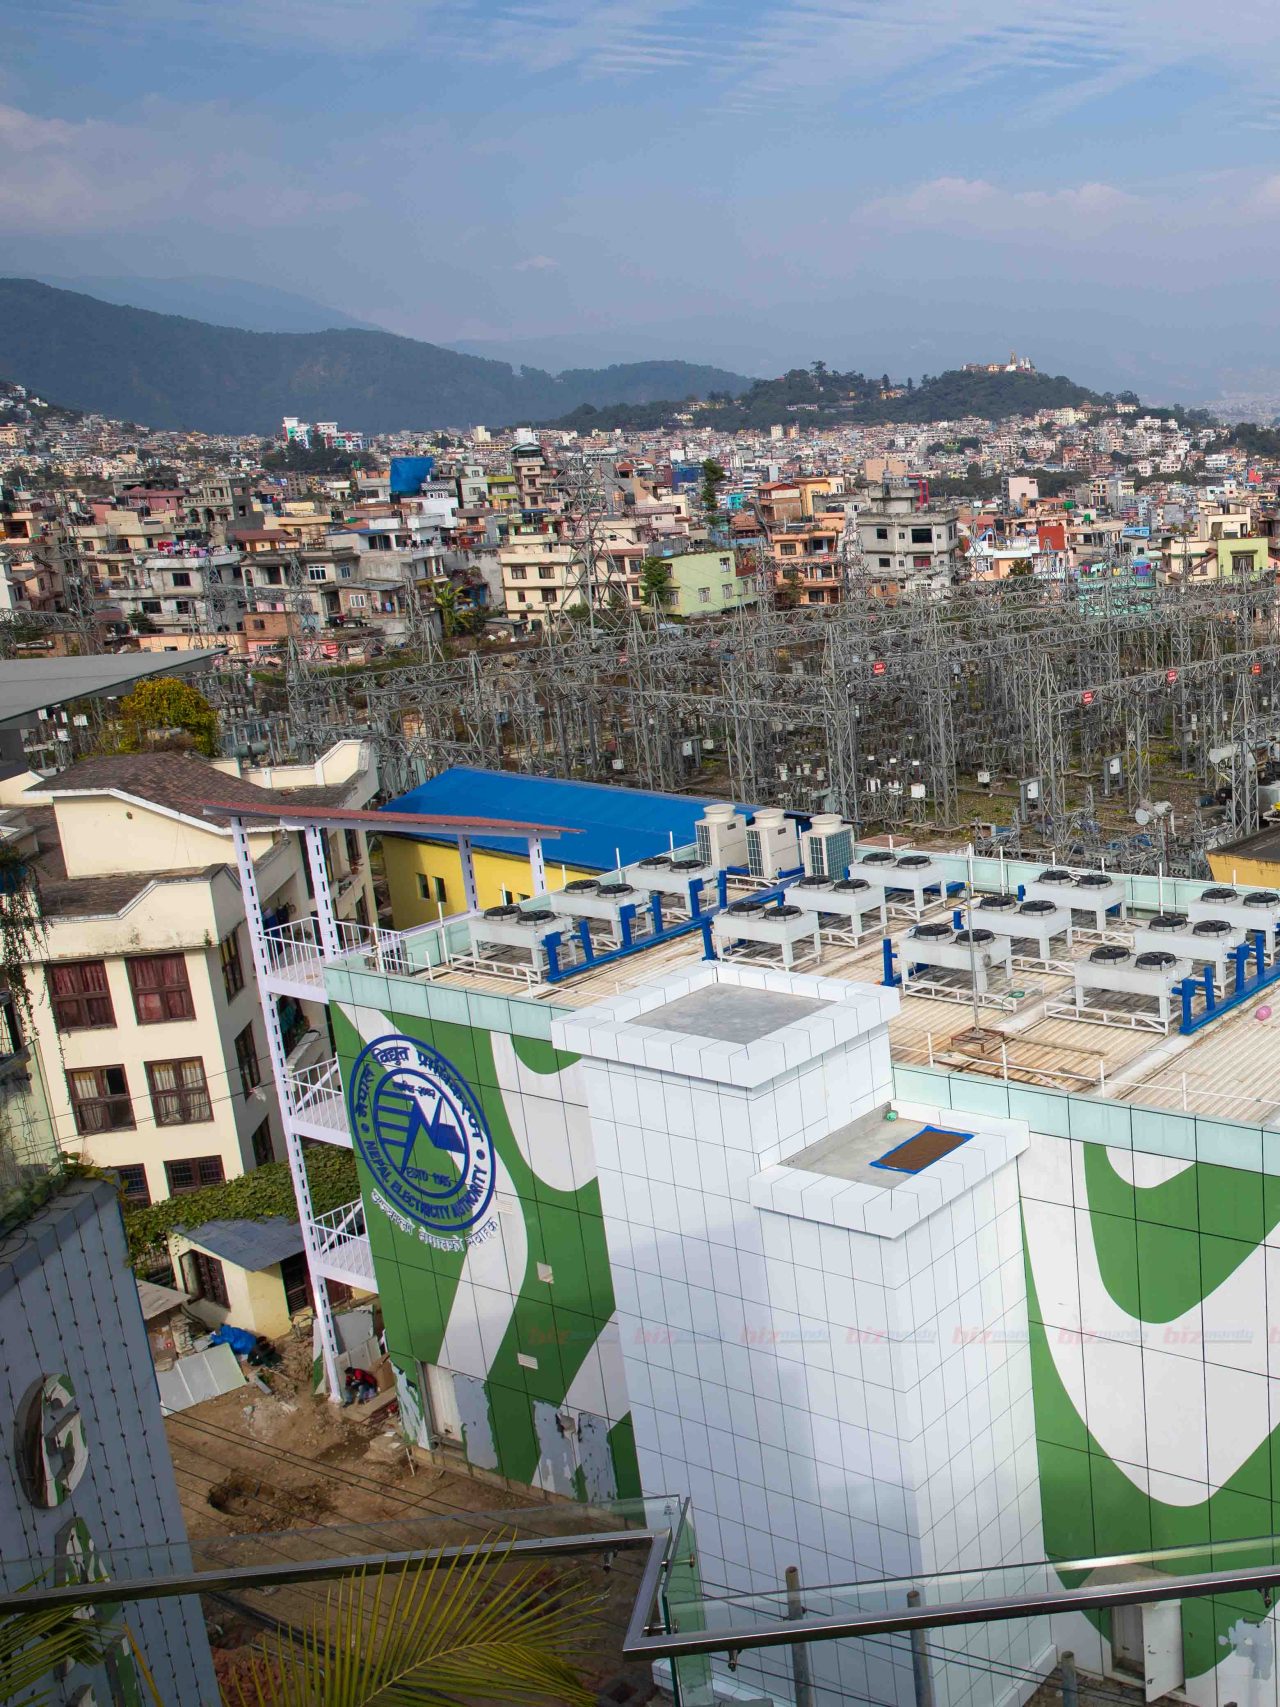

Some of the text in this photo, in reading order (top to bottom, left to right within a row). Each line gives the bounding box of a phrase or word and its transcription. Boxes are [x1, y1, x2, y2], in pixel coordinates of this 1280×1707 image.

[364, 1140, 488, 1219] NEPAL ELECTRICITY AUTHORITY
